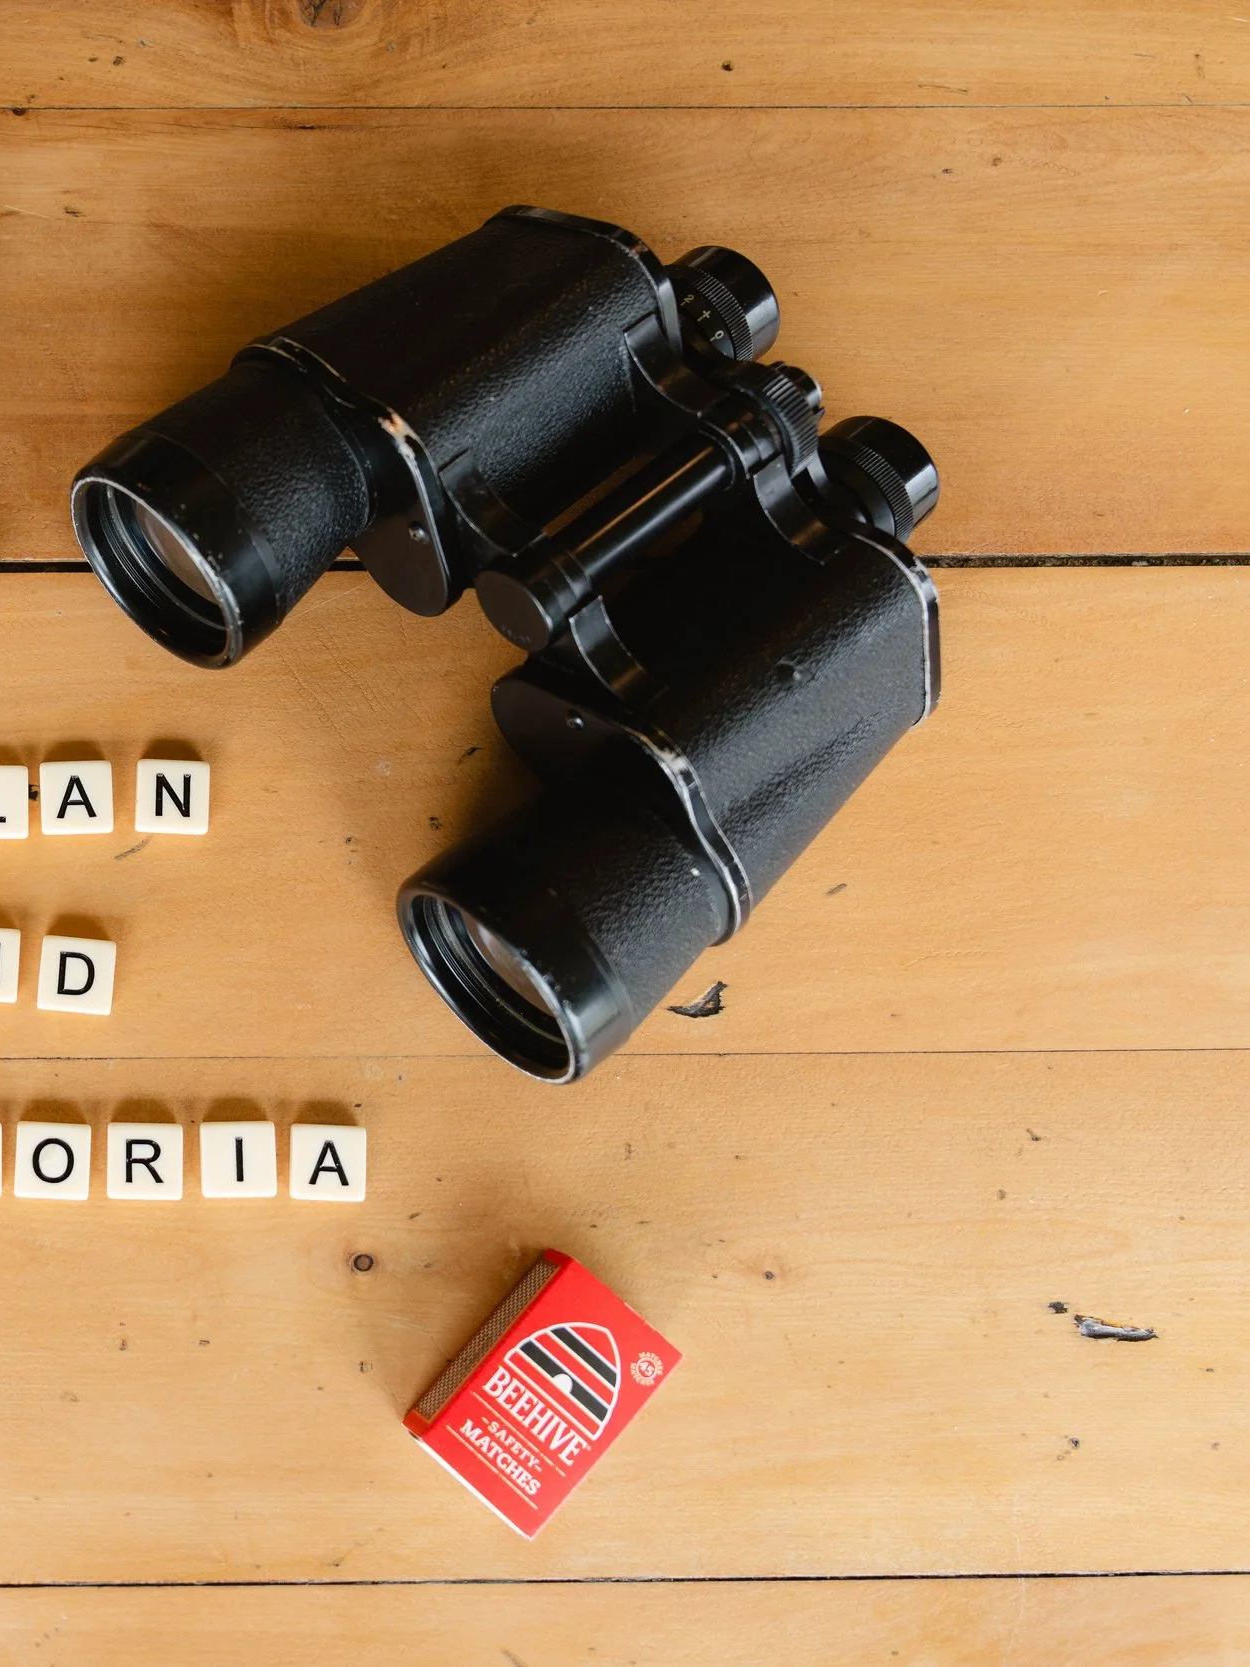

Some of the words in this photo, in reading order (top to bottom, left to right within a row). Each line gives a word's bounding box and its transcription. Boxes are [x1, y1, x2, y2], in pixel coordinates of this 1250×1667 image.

[639, 1361, 655, 1377] 45
[482, 1365, 588, 1467] BEEHIVE
[459, 1419, 542, 1495] MATCHES
